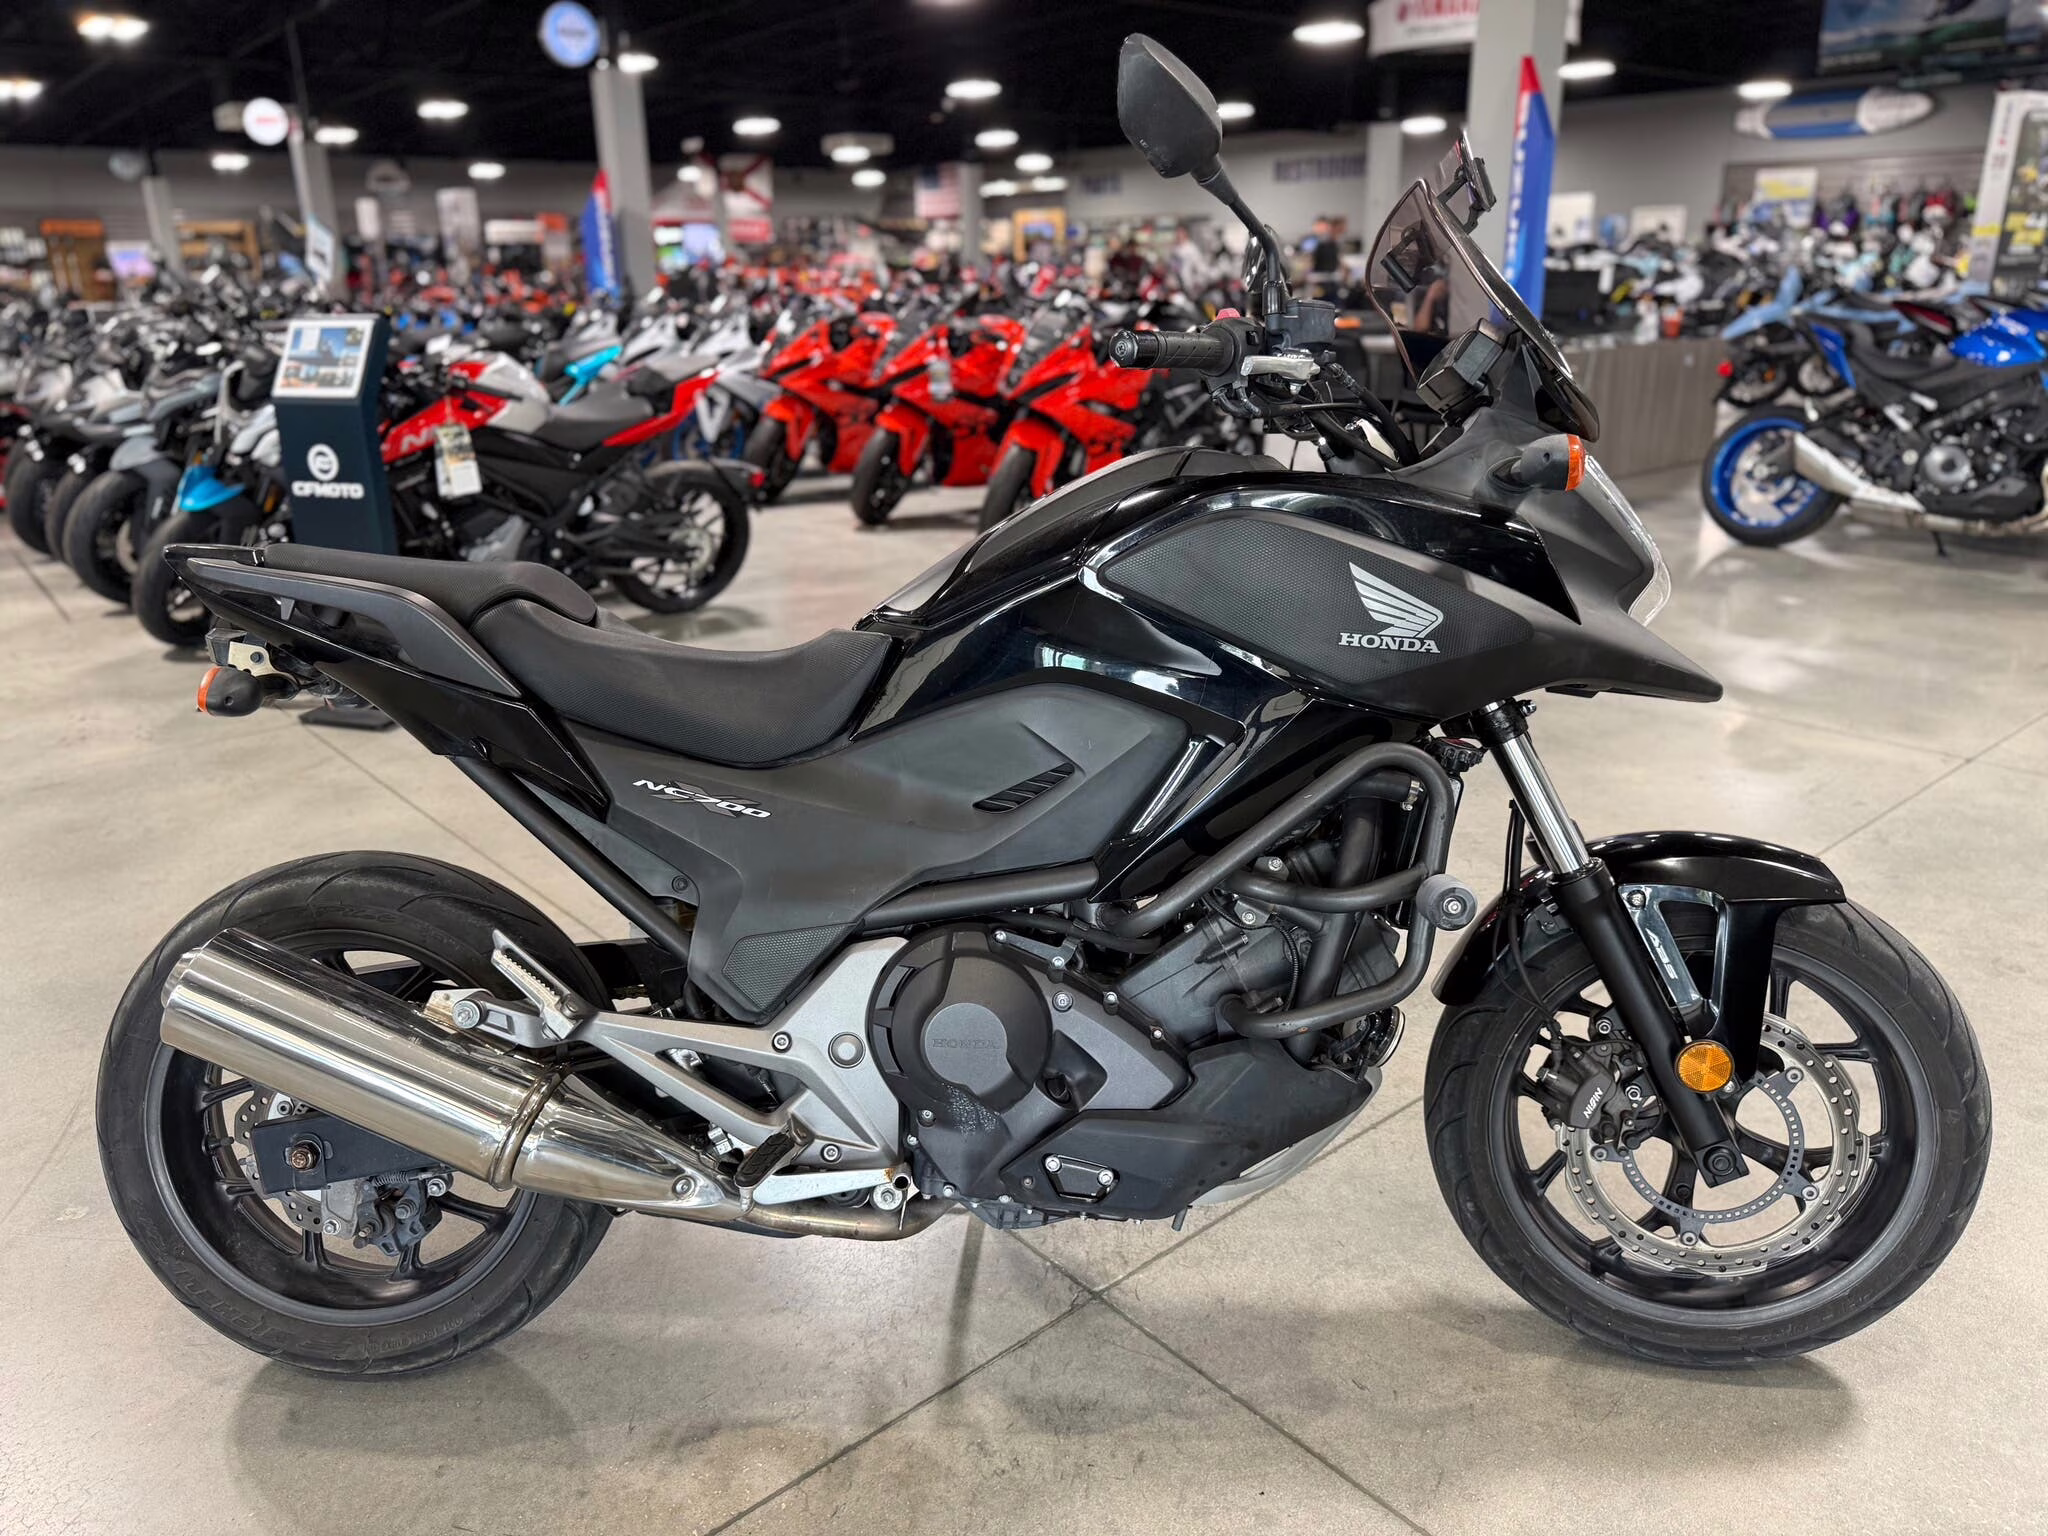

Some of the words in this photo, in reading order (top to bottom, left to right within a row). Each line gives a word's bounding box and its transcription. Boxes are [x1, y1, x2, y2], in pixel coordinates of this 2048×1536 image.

[291, 480, 365, 500] CFMOTO
[1338, 632, 1441, 654] HONDA
[1644, 927, 1679, 980] ABS
[932, 1038, 1001, 1050] HONDA
